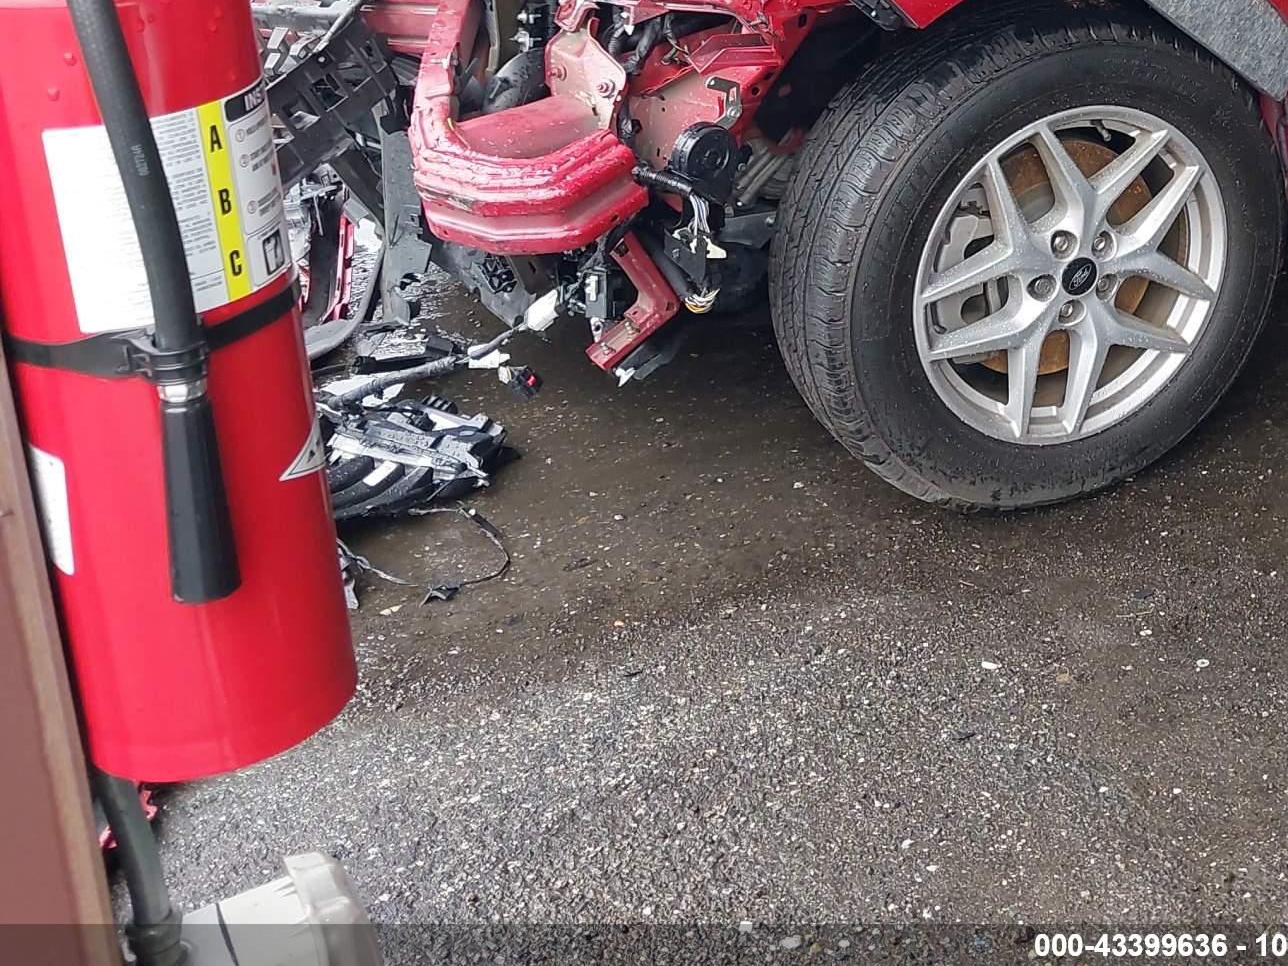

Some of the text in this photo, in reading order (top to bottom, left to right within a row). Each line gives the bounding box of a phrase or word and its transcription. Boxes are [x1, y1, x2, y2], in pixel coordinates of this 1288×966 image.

[209, 124, 223, 153] A
[218, 188, 232, 215] B
[229, 249, 242, 276] C
